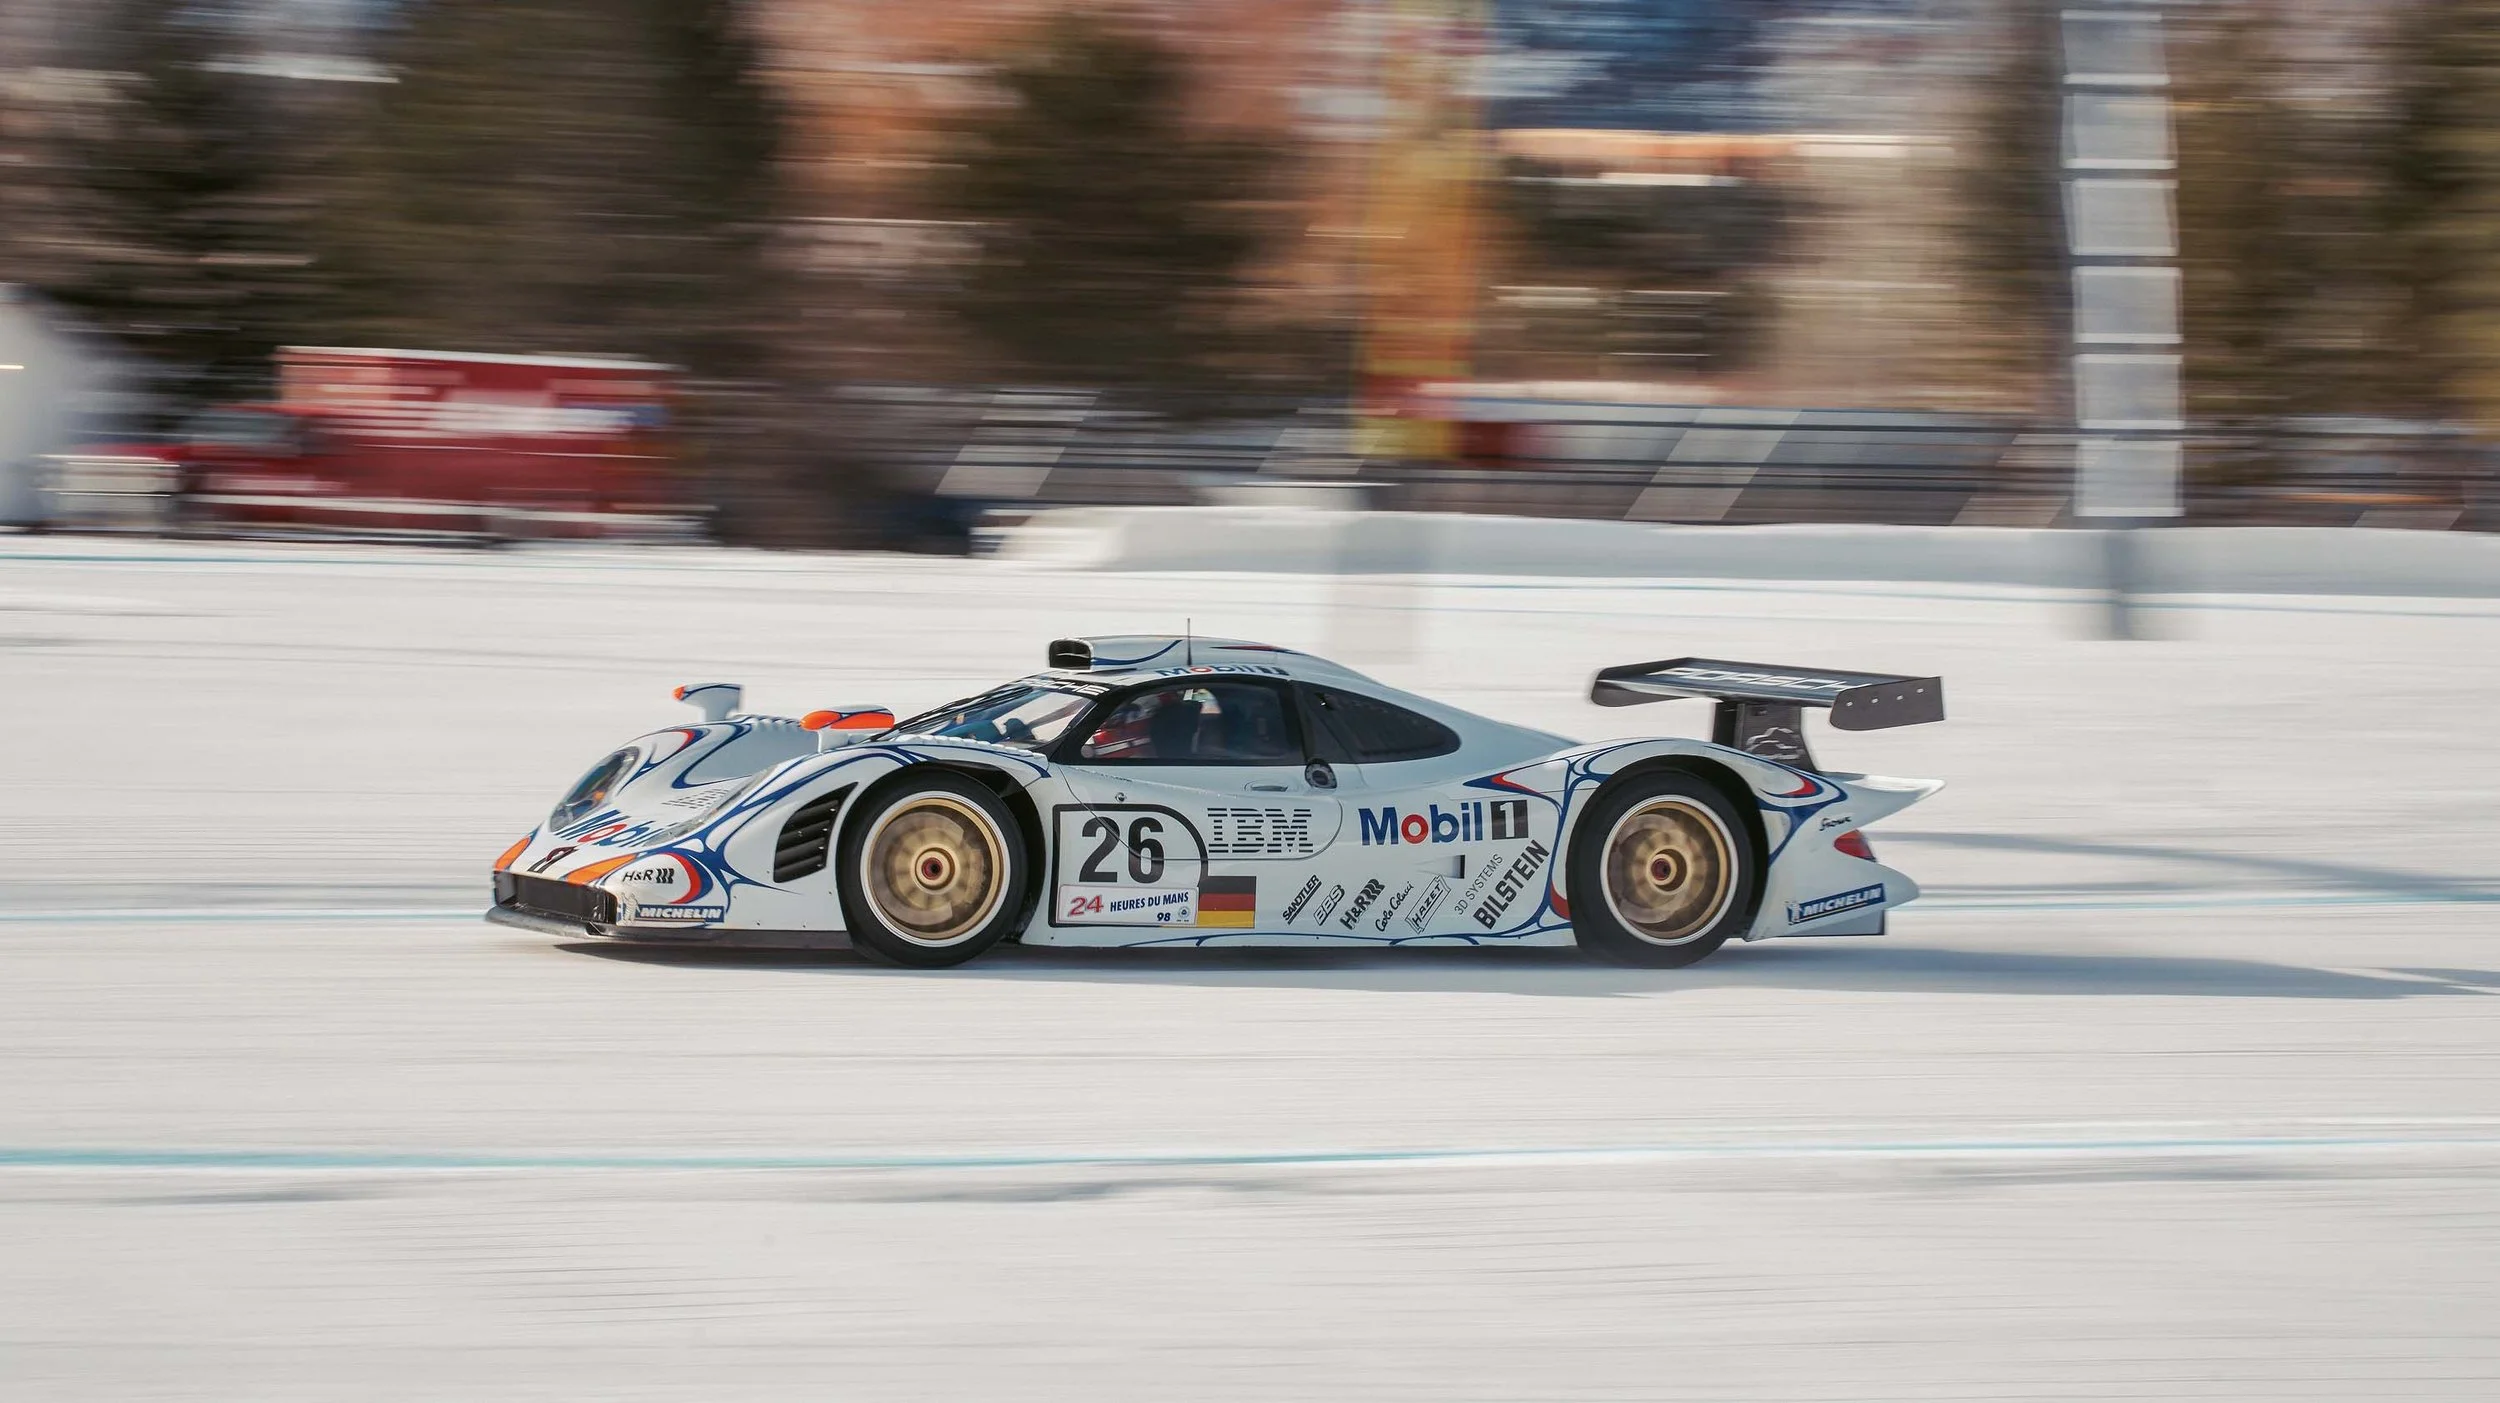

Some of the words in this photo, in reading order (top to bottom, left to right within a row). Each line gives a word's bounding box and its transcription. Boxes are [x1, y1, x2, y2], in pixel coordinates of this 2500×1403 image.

[1156, 665, 1255, 676] Mobil
[1646, 667, 1873, 692] PORSCH
[1207, 808, 1314, 853] IBM
[1358, 802, 1483, 845] Mobil
[1079, 816, 1165, 884] 26
[1068, 894, 1104, 917] 24
[1110, 898, 1146, 912] HEURES
[1147, 895, 1161, 907] DU
[1162, 891, 1190, 905] MANS
[1282, 874, 1320, 921] SANDTLER
[1411, 882, 1442, 928] HAZET
[1454, 901, 1469, 916] 3D
[1465, 853, 1504, 900] SYSTEMS
[1473, 839, 1550, 930] BILSTEIN
[1803, 887, 1882, 916] MICHELIN
[641, 907, 723, 919] MICHELIN
[1156, 912, 1172, 922] 98
